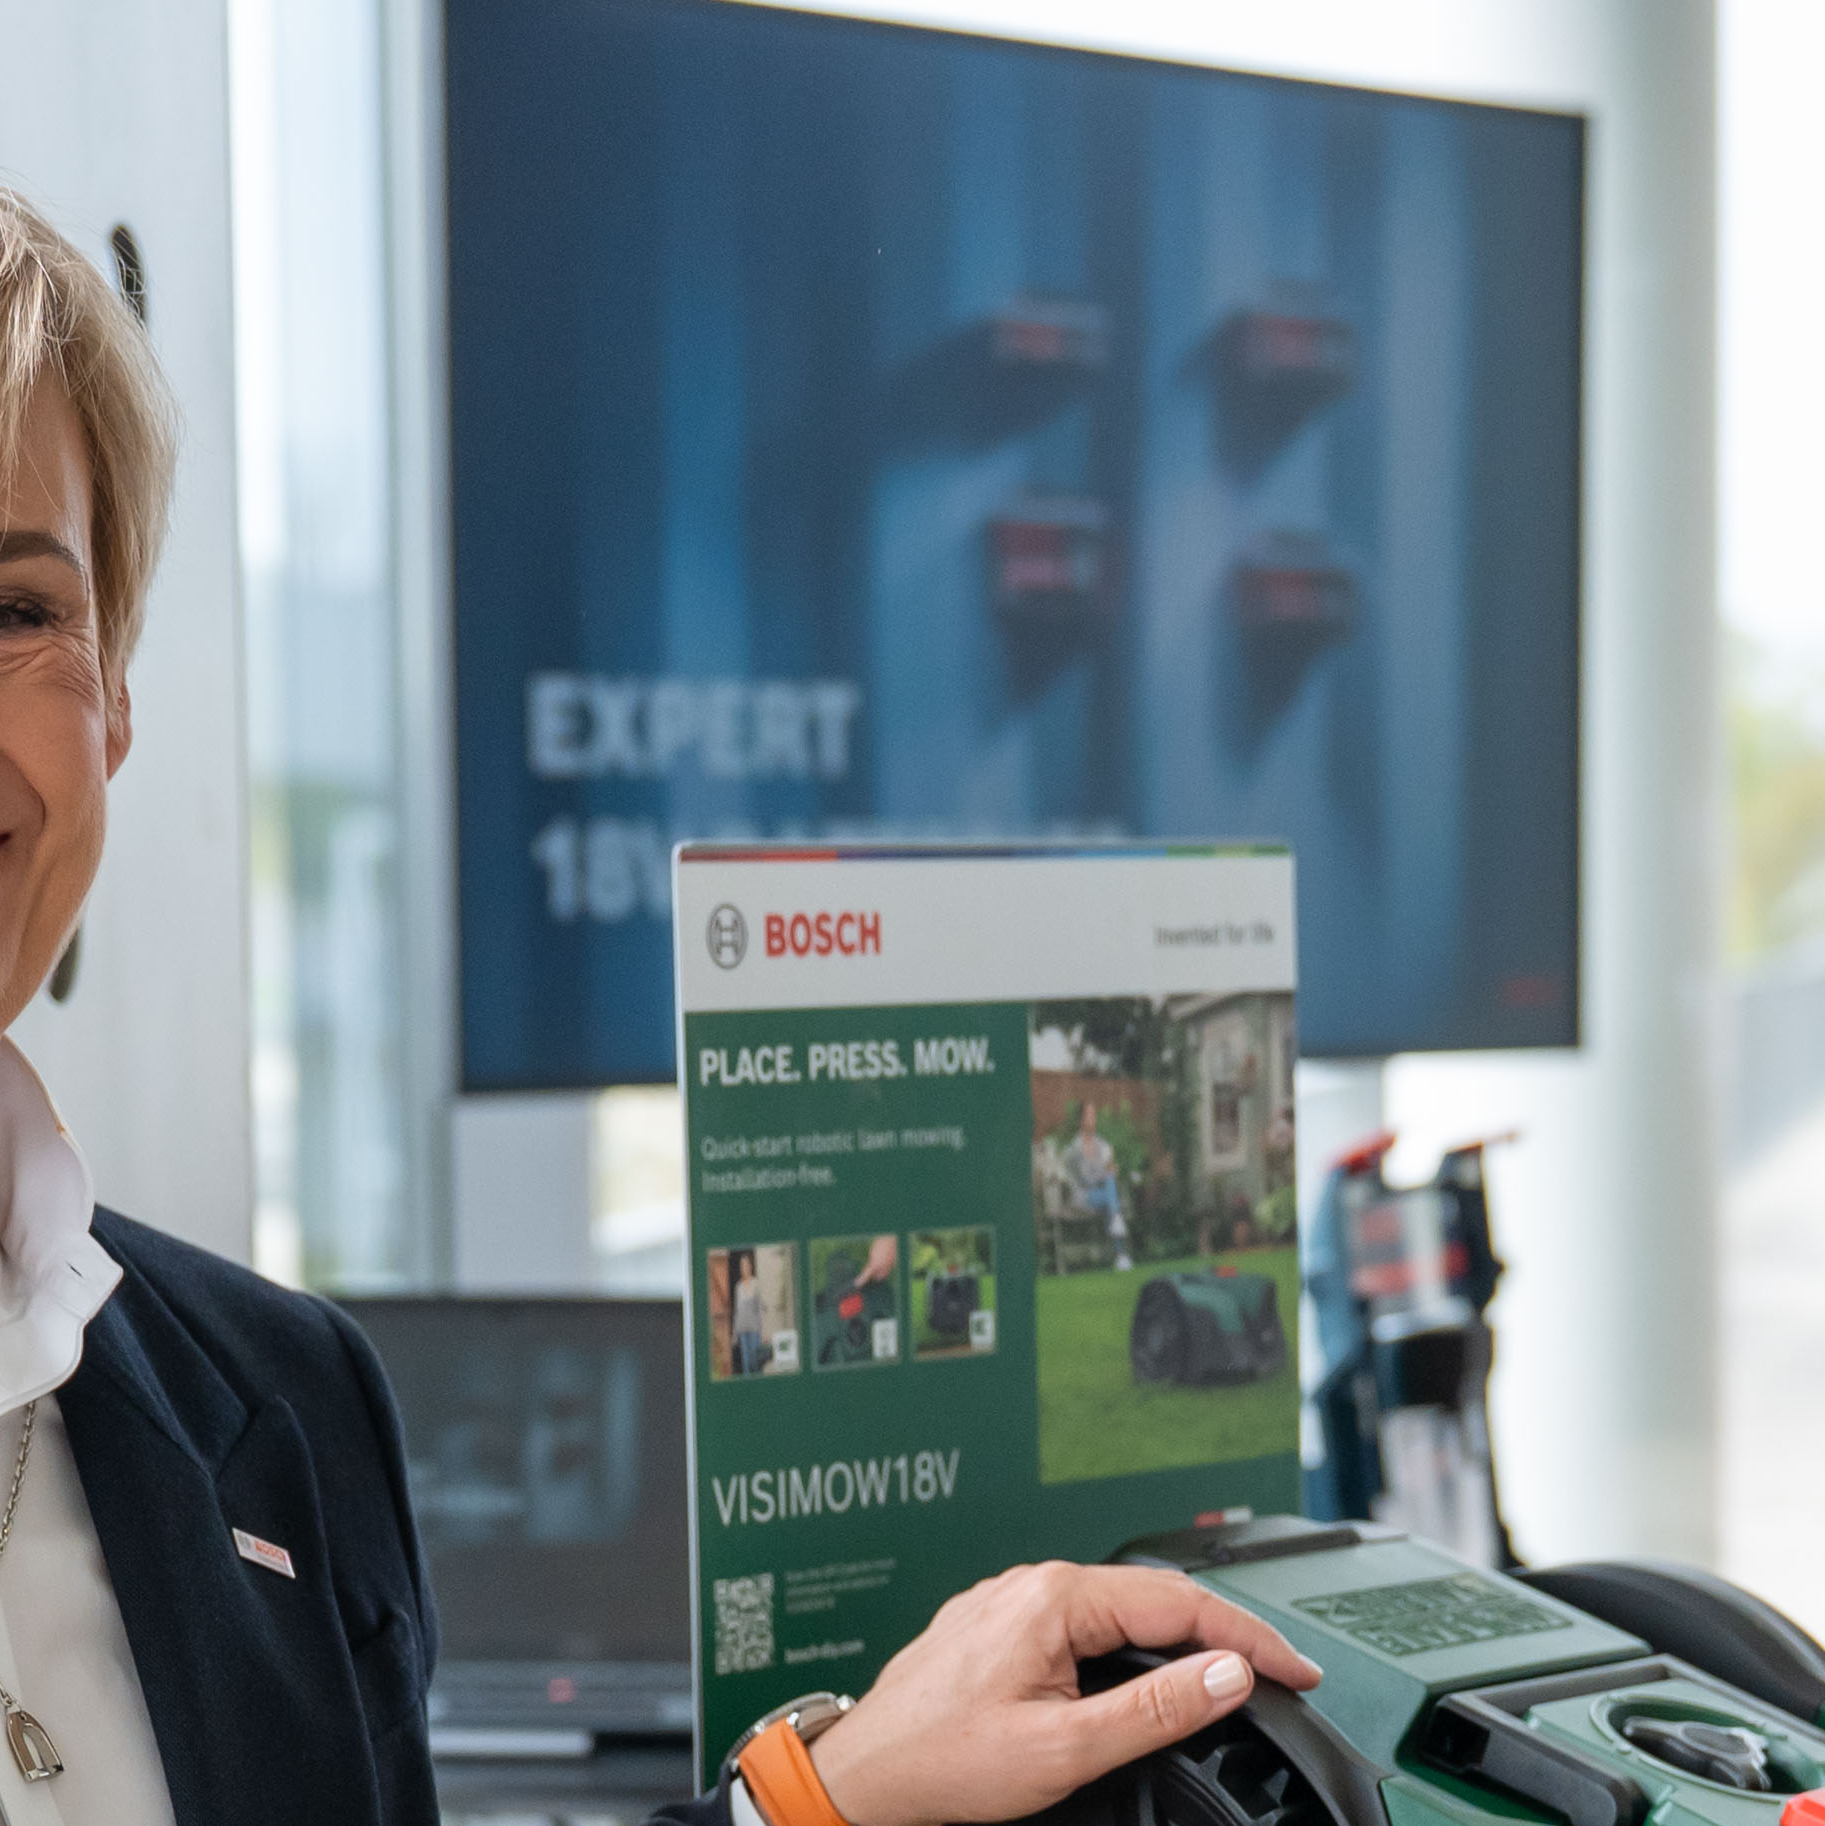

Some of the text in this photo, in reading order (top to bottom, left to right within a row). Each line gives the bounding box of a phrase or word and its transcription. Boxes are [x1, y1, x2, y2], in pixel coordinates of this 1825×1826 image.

[528, 672, 858, 778] EXPERT
[763, 910, 882, 958] BOSCH
[699, 1034, 996, 1087] PLACE. PRESS. MOW.
[711, 1448, 961, 1527] VISIMOW18V
